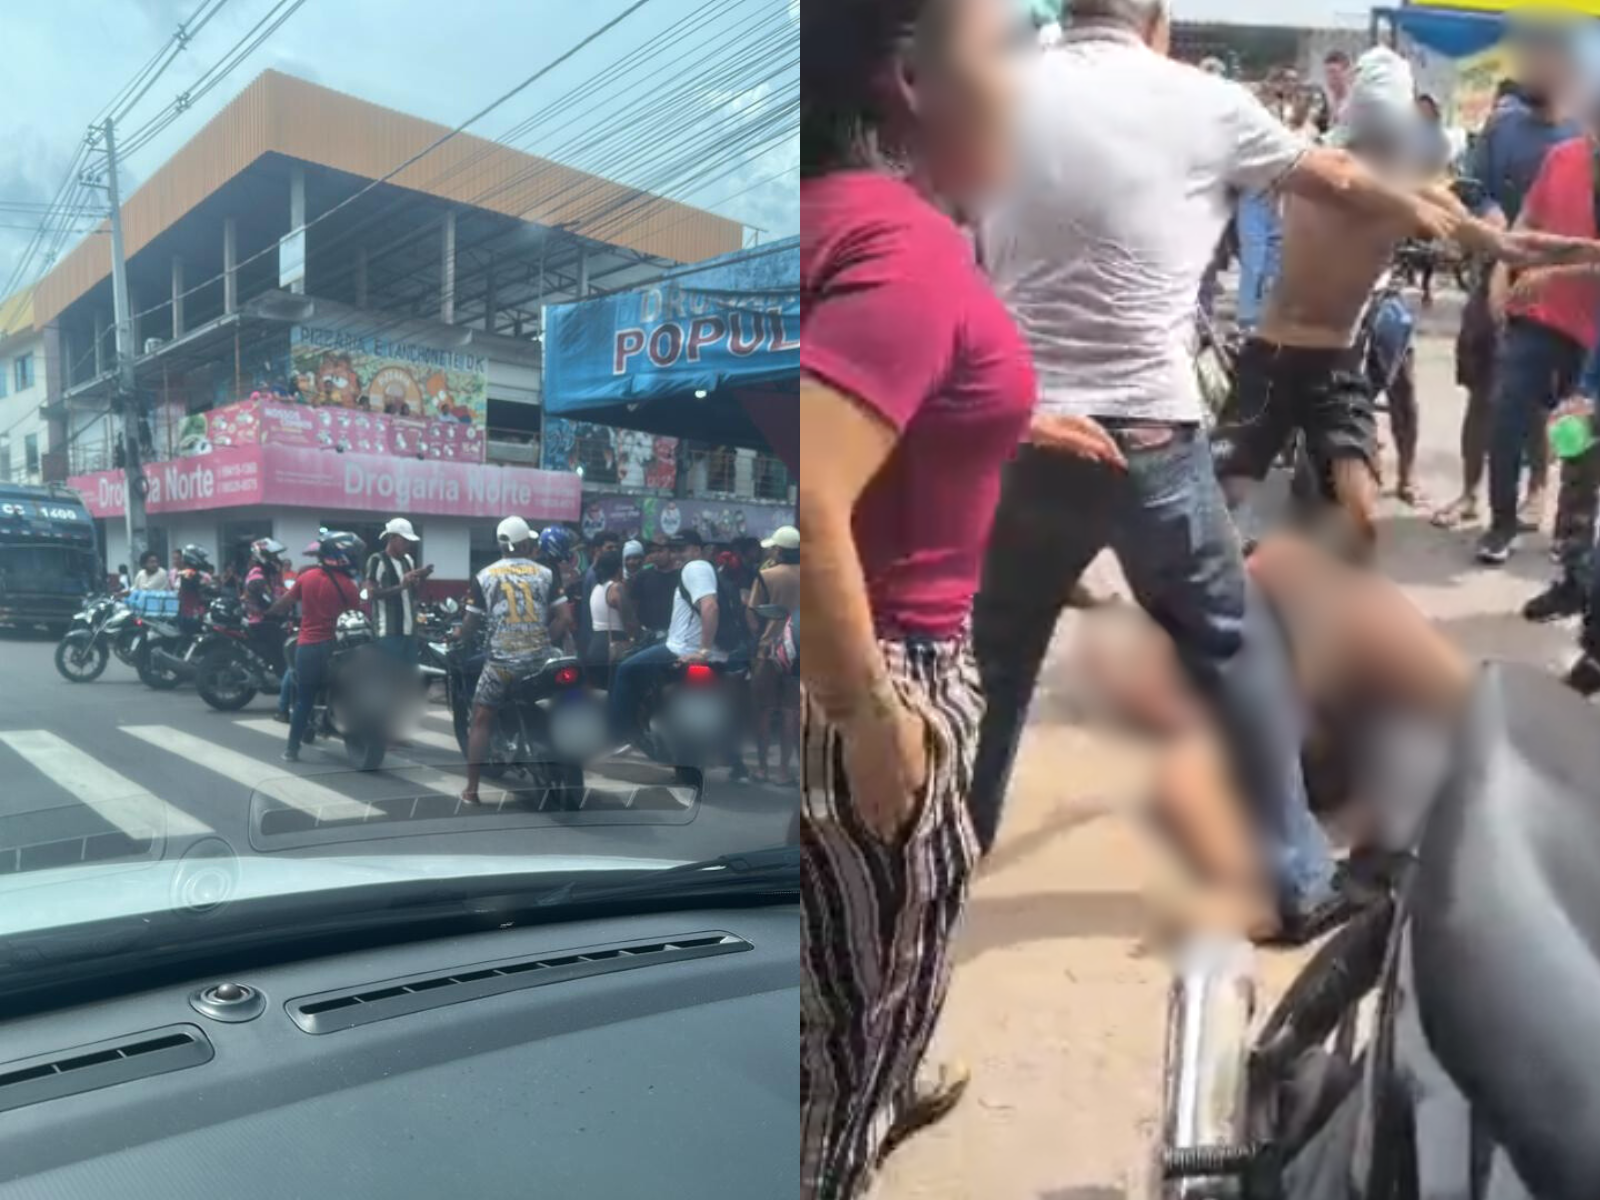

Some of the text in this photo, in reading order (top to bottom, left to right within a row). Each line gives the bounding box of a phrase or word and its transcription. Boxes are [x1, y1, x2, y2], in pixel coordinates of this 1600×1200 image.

[374, 337, 384, 357] E
[465, 354, 486, 374] DK
[613, 306, 800, 376] POPUL
[98, 470, 161, 509] Droia
[164, 464, 214, 501] Norte
[343, 460, 532, 507] Drogaria Norte
[500, 581, 539, 624] 11
